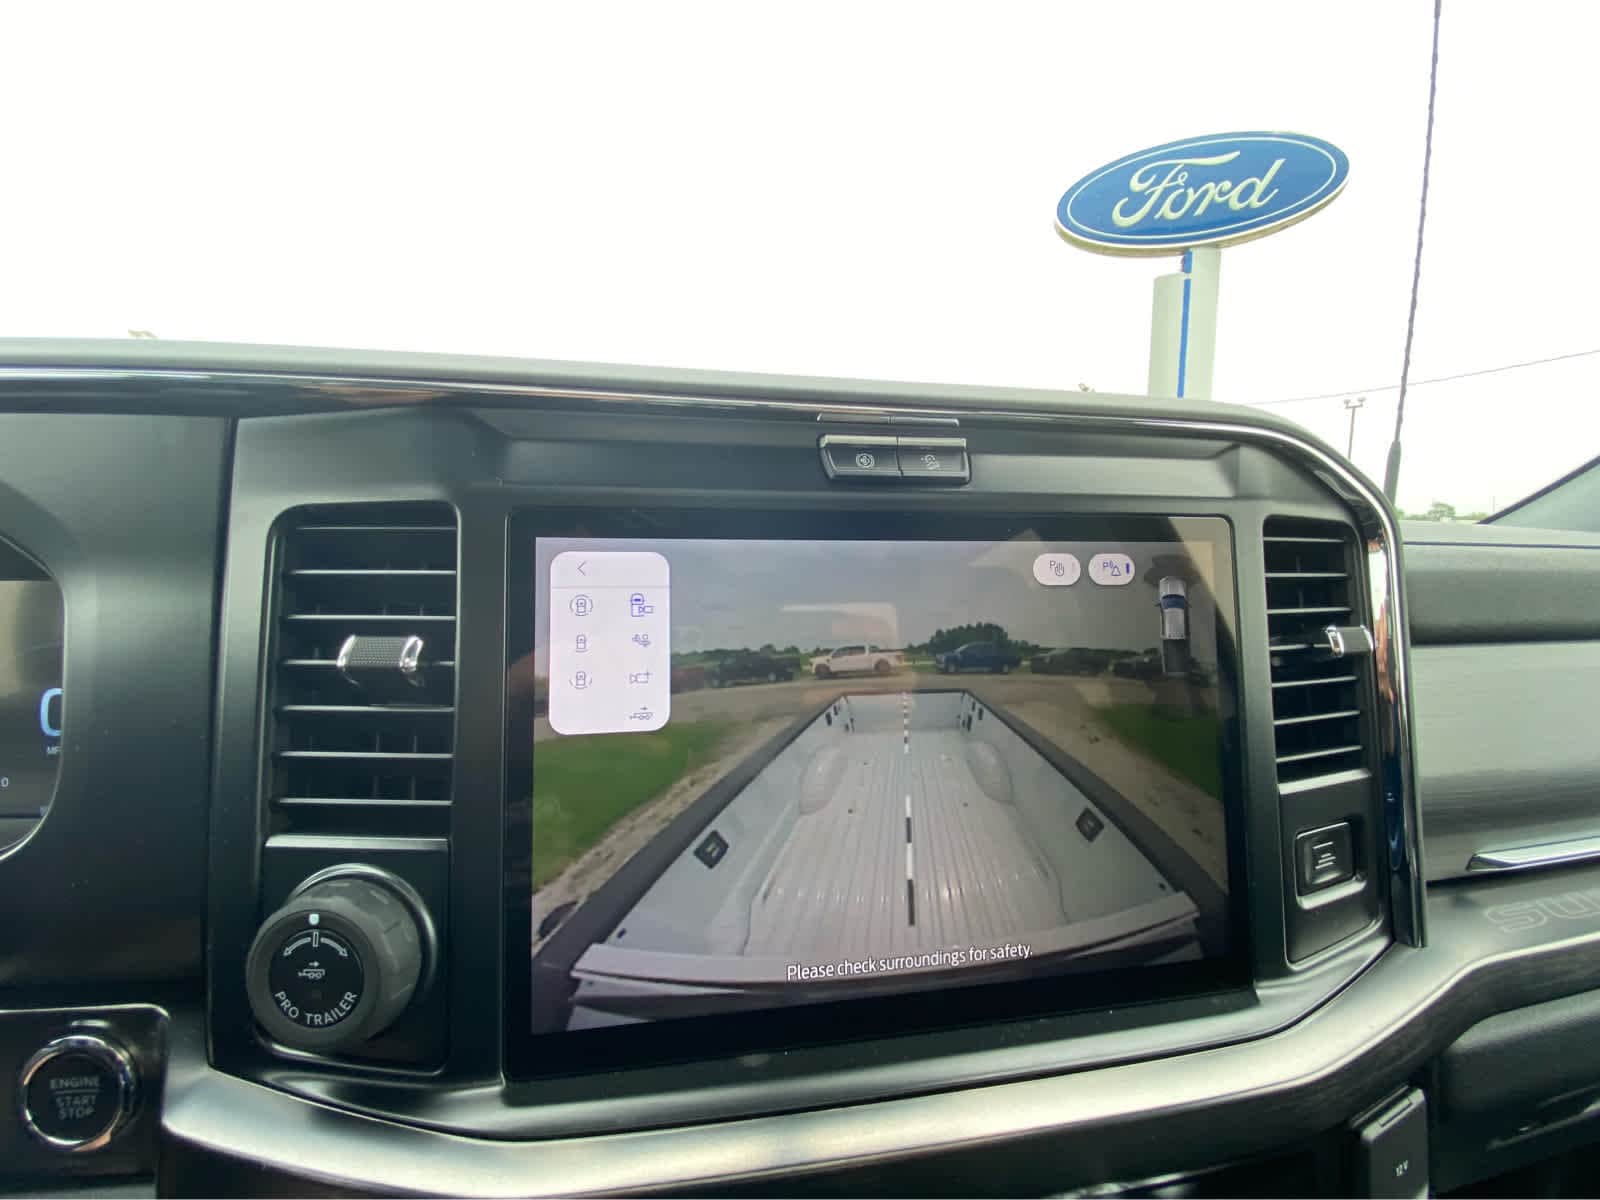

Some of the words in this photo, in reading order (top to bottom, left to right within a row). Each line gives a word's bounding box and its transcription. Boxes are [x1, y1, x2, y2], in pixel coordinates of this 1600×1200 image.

[1112, 150, 1286, 228] Ford
[786, 964, 835, 981] Please
[837, 956, 877, 976] check
[879, 950, 966, 968] surroundings
[968, 946, 988, 961] for
[990, 943, 1033, 960] safety.
[275, 991, 299, 1018] PRO
[305, 991, 358, 1025] TRAILER
[49, 1076, 100, 1090] ENGINE
[56, 1095, 97, 1107] START
[58, 1106, 96, 1120] STOP
